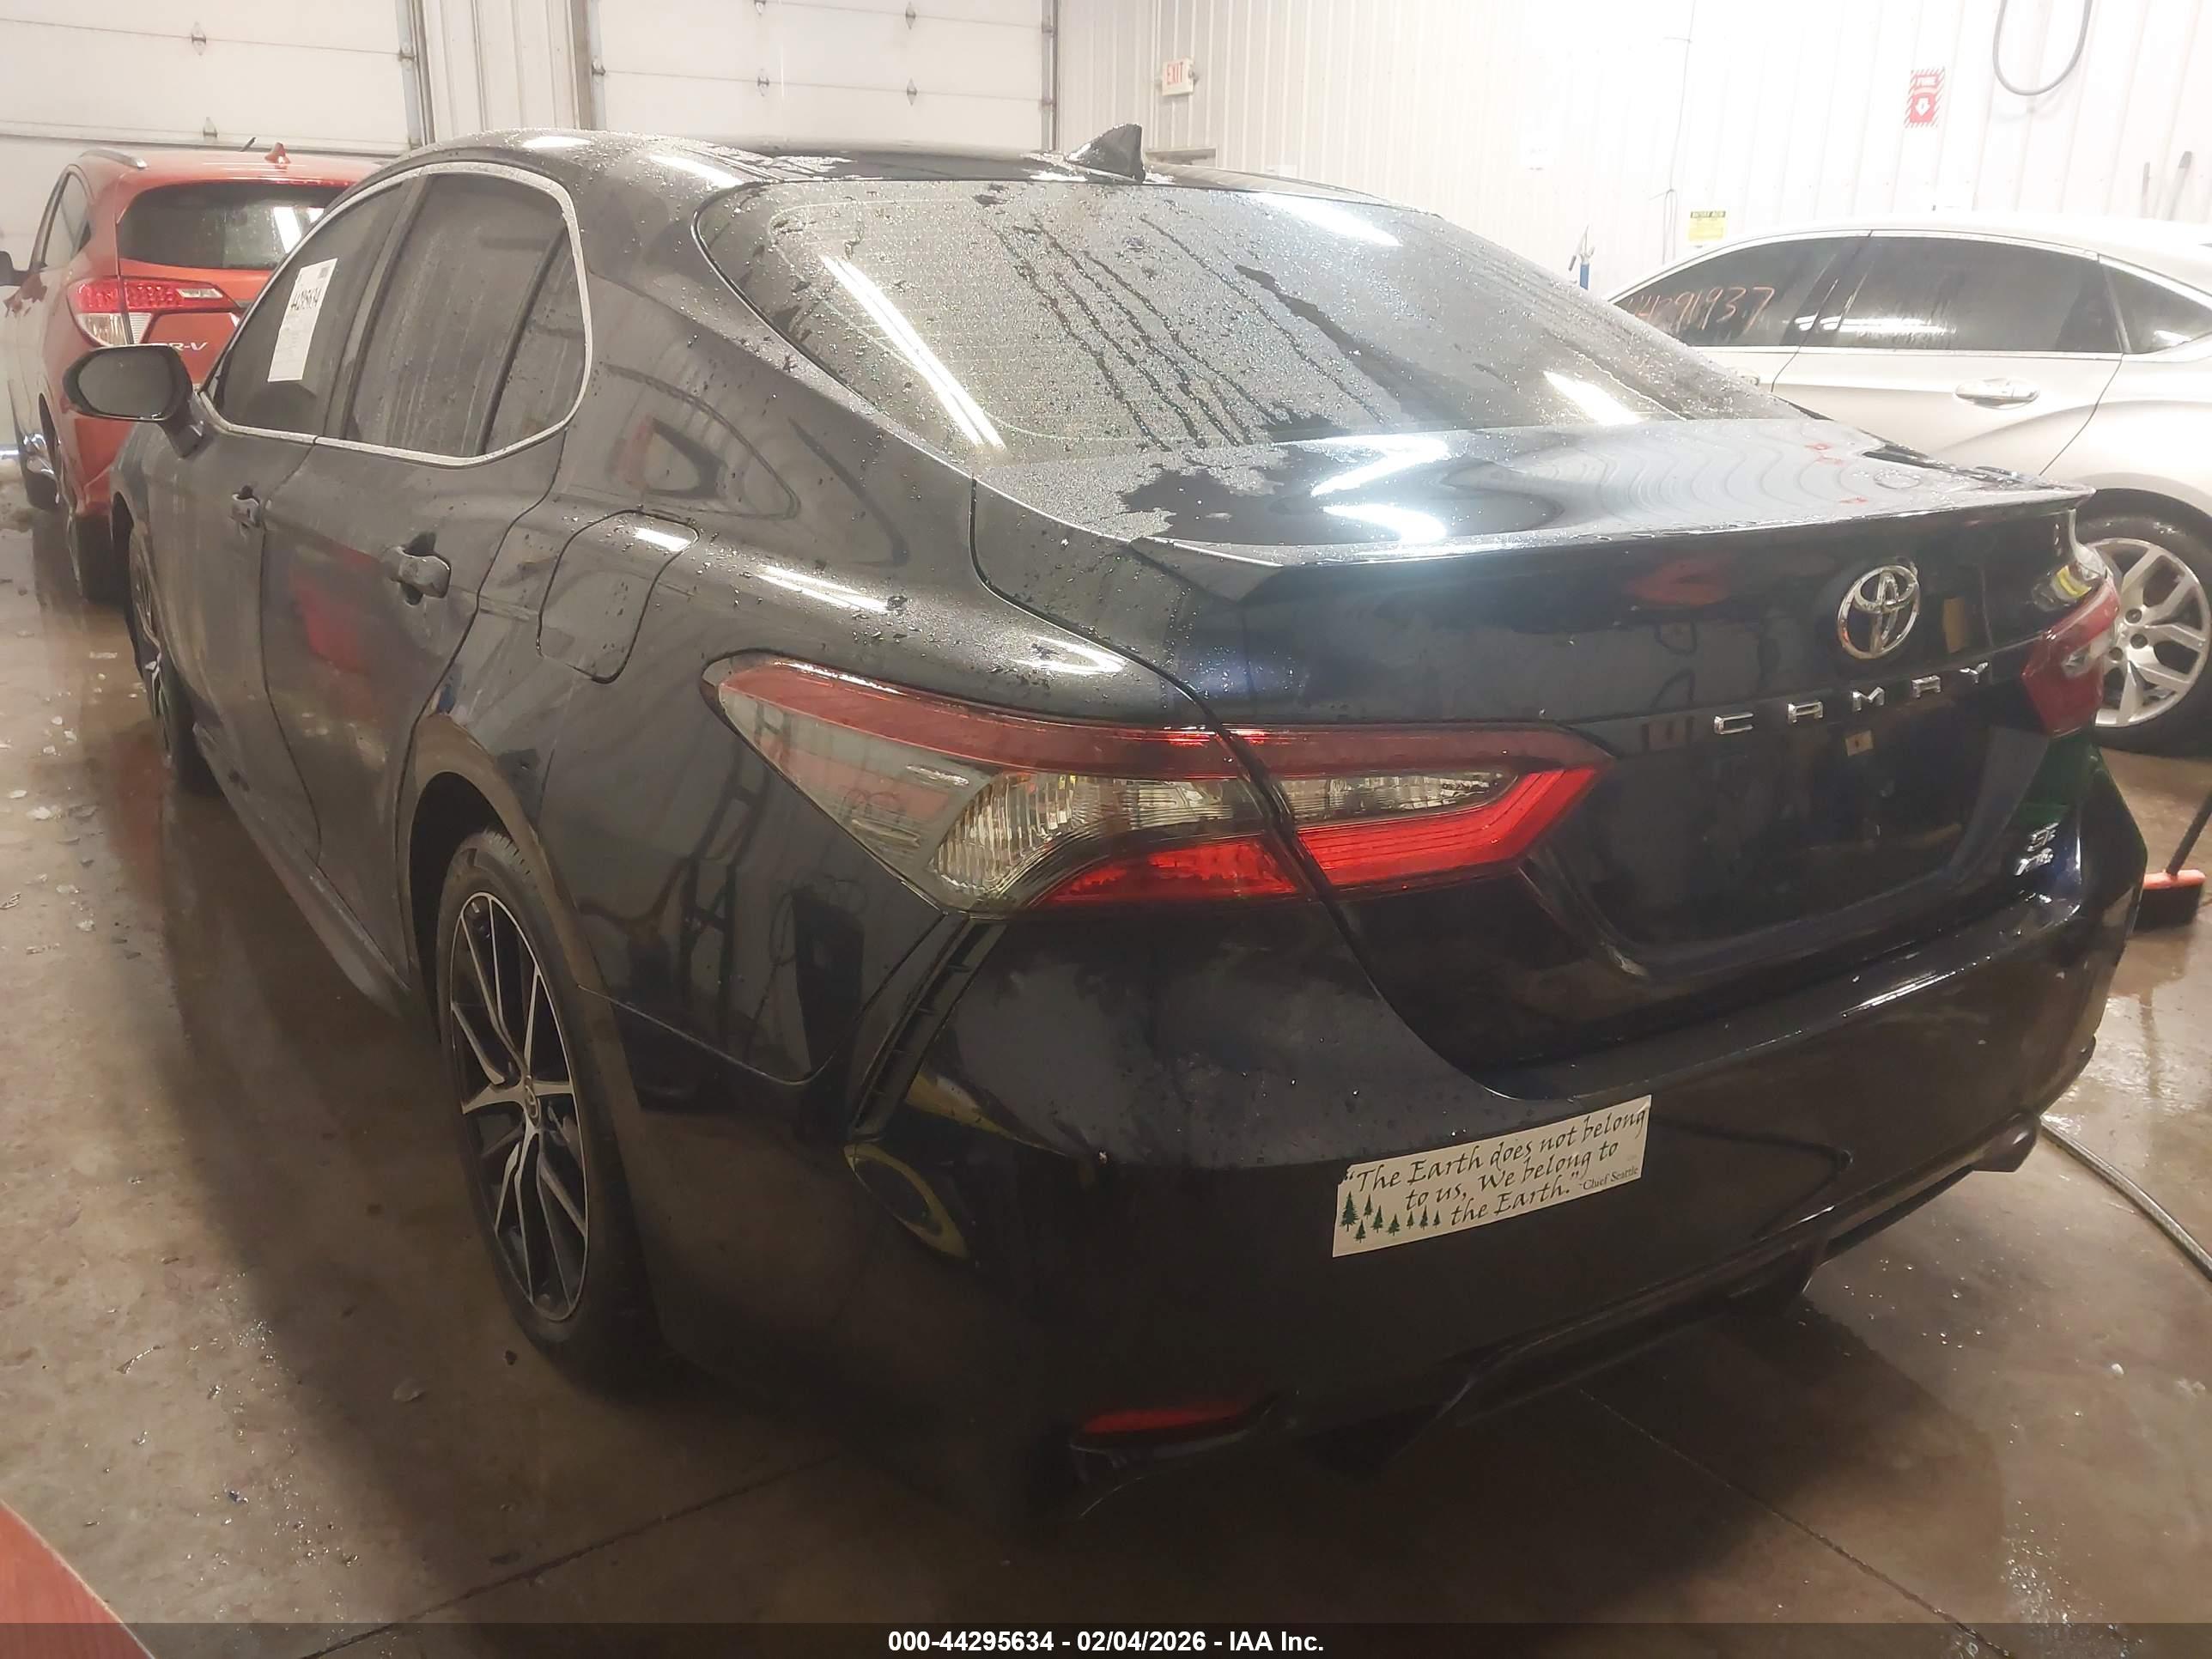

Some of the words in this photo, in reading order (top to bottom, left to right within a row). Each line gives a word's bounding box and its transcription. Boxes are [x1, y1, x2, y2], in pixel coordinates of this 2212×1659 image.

[1167, 61, 1183, 85] EXIT
[168, 342, 208, 351] R-V
[1714, 662, 1989, 735] CAMRY
[1407, 1146, 1484, 1185] Earth
[1490, 1141, 1532, 1171] does
[1540, 1126, 1577, 1152] not
[1580, 1109, 1646, 1143] belong
[1405, 1188, 1429, 1212] to
[1435, 1183, 1467, 1201] us,
[1477, 1170, 1515, 1192] We
[1522, 1152, 1592, 1183] belong
[1599, 1140, 1619, 1158] to
[1611, 1166, 1639, 1182] Seattle
[1450, 1197, 1487, 1225] the
